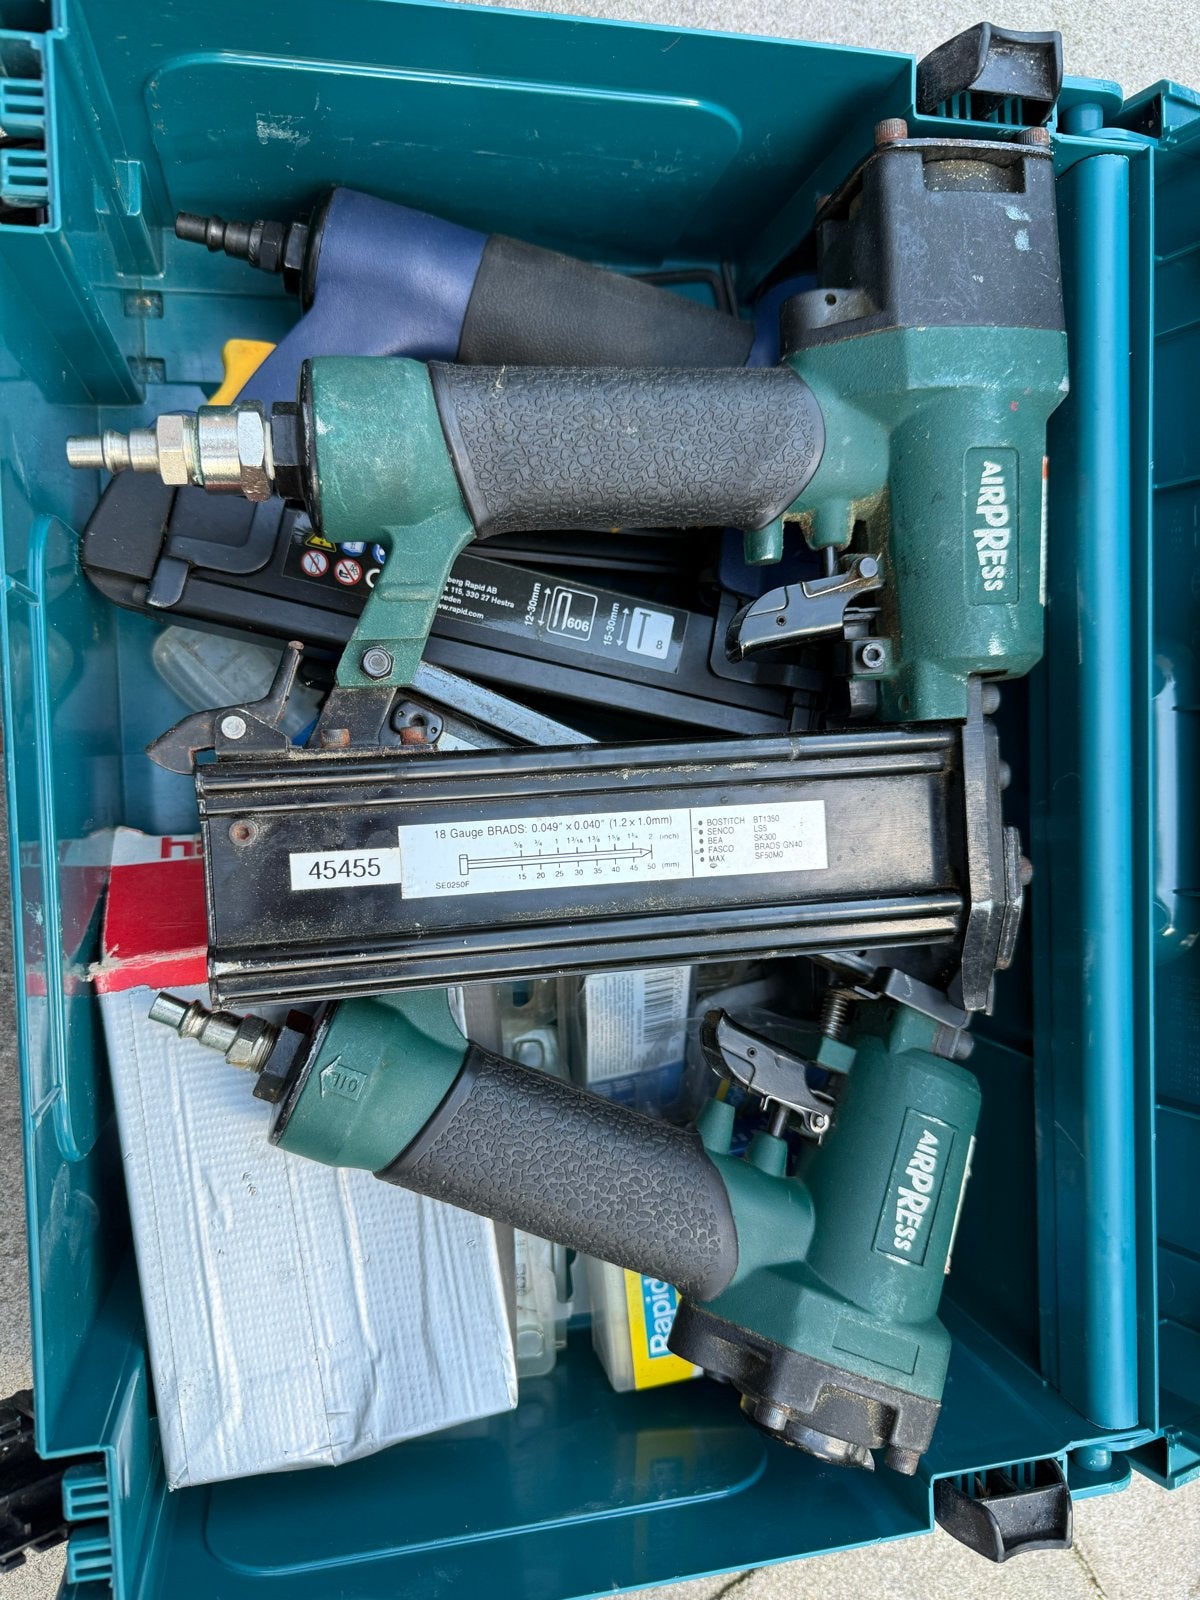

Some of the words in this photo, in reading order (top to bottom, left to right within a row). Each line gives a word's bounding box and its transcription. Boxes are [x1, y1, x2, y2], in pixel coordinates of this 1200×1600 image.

[973, 460, 1011, 592] AIRPRESS
[464, 580, 486, 592] Rapid
[486, 586, 498, 595] AB
[451, 586, 464, 596] 115,
[466, 590, 480, 600] 330
[481, 594, 489, 602] 27
[491, 597, 515, 609] Hestra
[524, 582, 542, 626] 12-30mm
[567, 617, 590, 632] 606
[603, 602, 620, 646] 15-30mm
[655, 640, 663, 650] 8
[434, 829, 446, 839] 18
[450, 828, 483, 840] Gauge
[487, 824, 527, 836] BRADS:
[609, 818, 628, 830] (1.2
[638, 815, 673, 827] 1.0mm)
[706, 816, 746, 827] BOSTITCH
[752, 814, 780, 824] BT1350
[659, 832, 680, 840] (inch)
[706, 826, 735, 836] SENCO
[753, 824, 768, 833] LS5
[707, 836, 724, 845] BEA
[753, 833, 777, 842] SK300
[708, 844, 735, 854] FASCO
[782, 840, 803, 849] GN40
[708, 854, 726, 863] MAX
[308, 857, 381, 880] 45455
[536, 872, 546, 880] 20
[555, 870, 564, 878] 25
[574, 868, 584, 876] 30
[593, 867, 603, 875] 35
[611, 865, 621, 873] 40
[629, 864, 639, 872] 45
[647, 862, 657, 870] 50
[661, 861, 680, 869] (mm)
[893, 1129, 938, 1252] AIRPRESS
